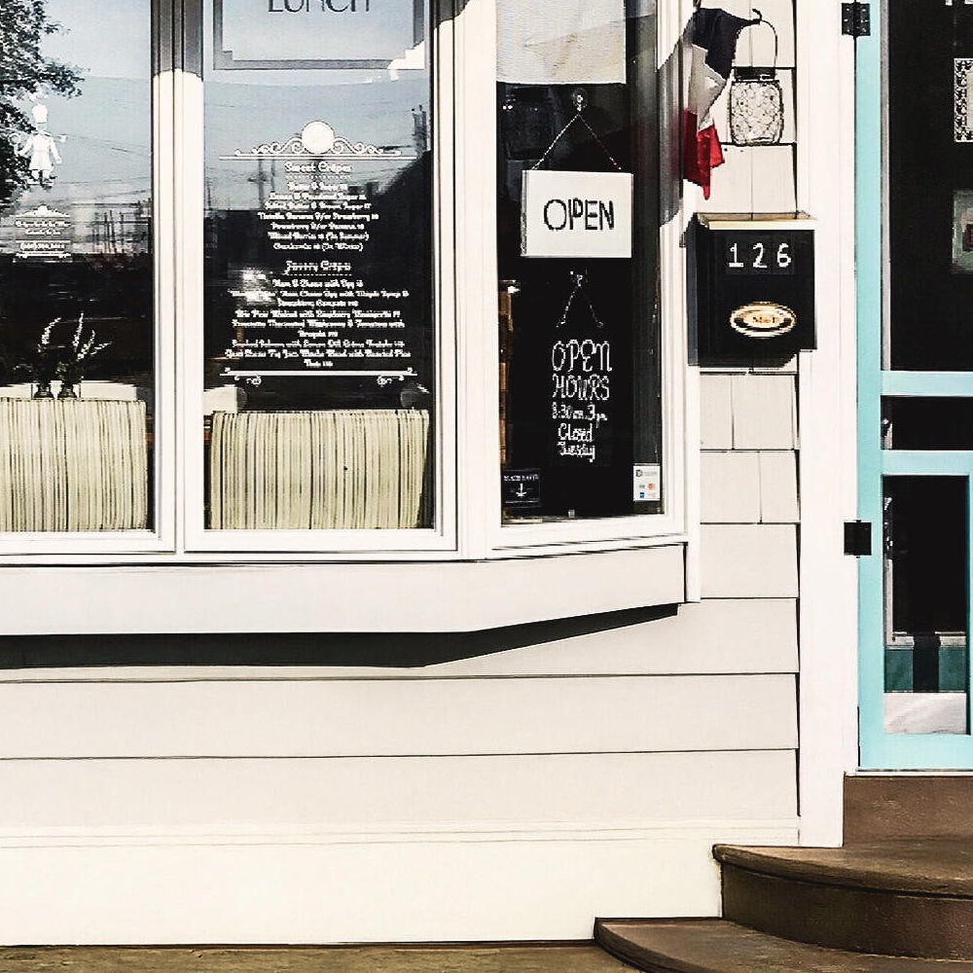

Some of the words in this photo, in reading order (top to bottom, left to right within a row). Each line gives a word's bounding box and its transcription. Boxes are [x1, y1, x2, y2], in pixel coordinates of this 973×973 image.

[543, 199, 615, 231] OPEN
[729, 242, 791, 268] 126
[551, 339, 613, 372] OPEN
